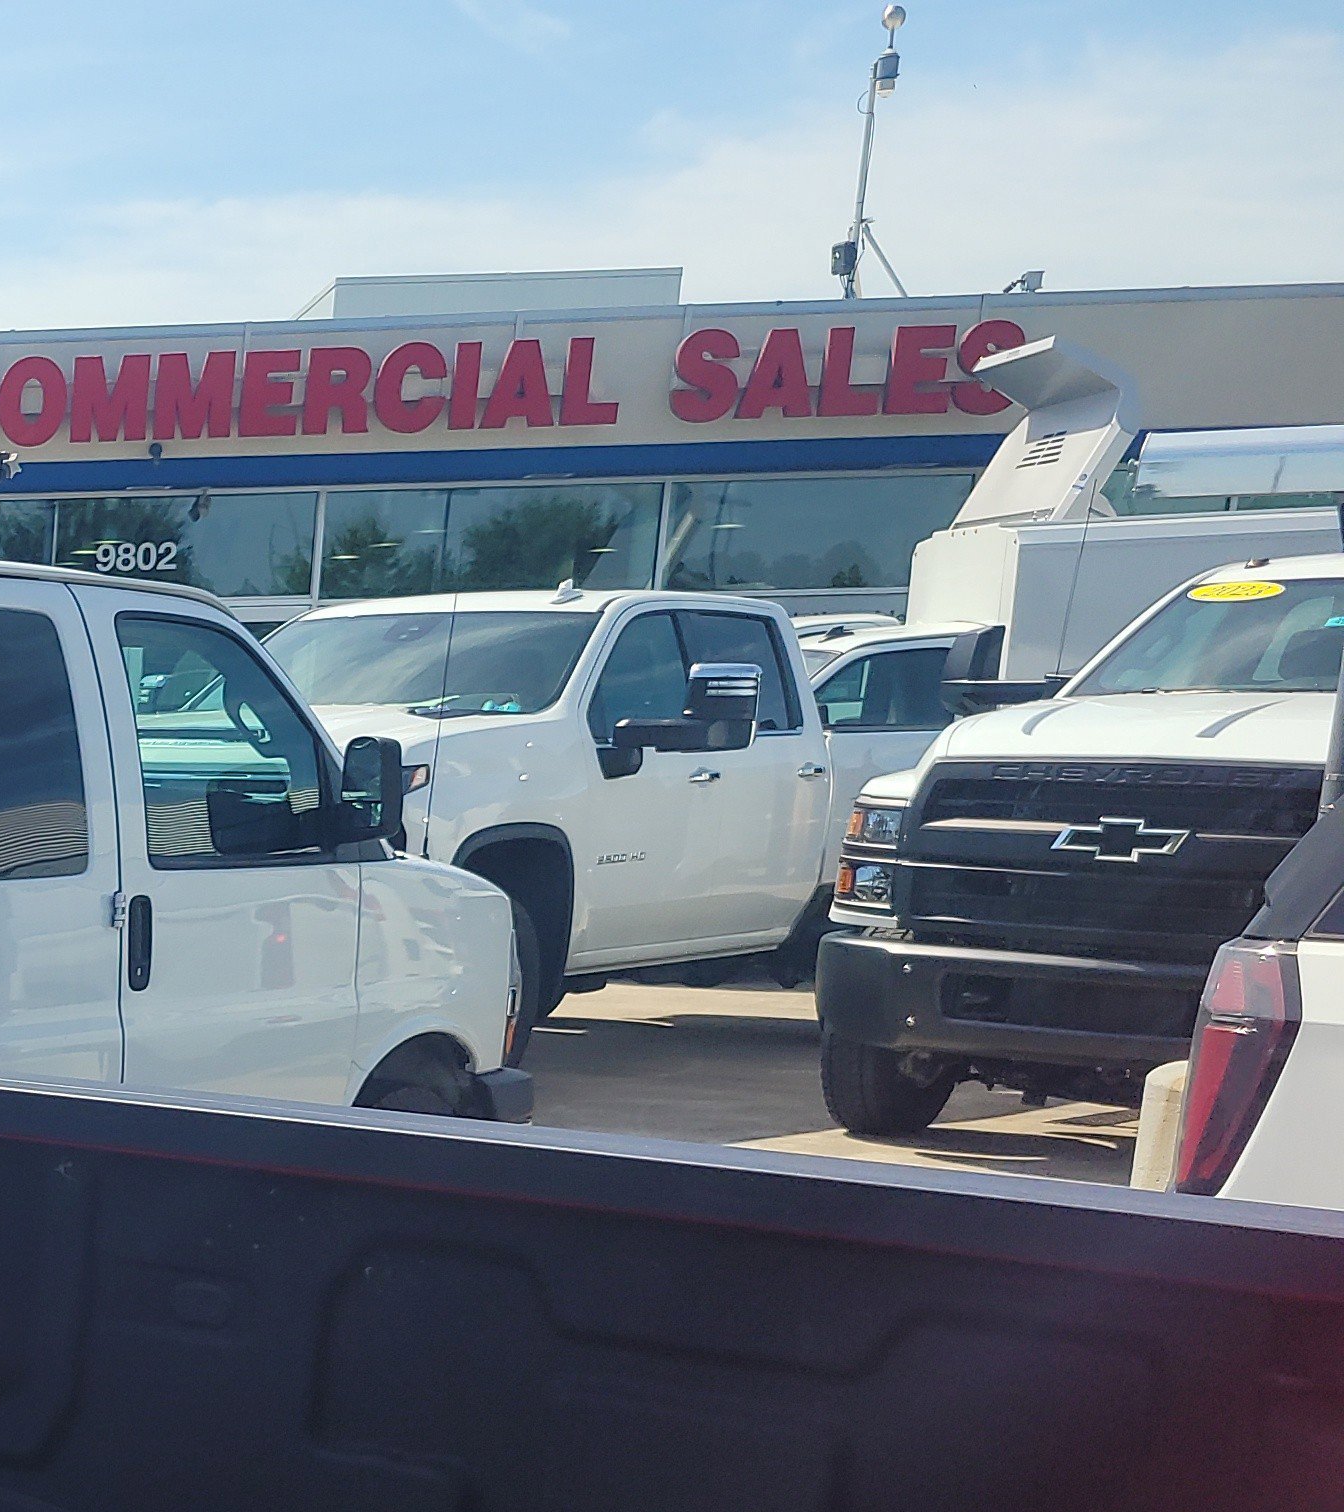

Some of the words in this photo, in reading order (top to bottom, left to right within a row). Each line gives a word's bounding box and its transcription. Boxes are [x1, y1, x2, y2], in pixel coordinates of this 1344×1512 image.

[669, 319, 1026, 424] SALES
[95, 541, 178, 572] 9802
[992, 765, 1298, 787] CHEVROLET
